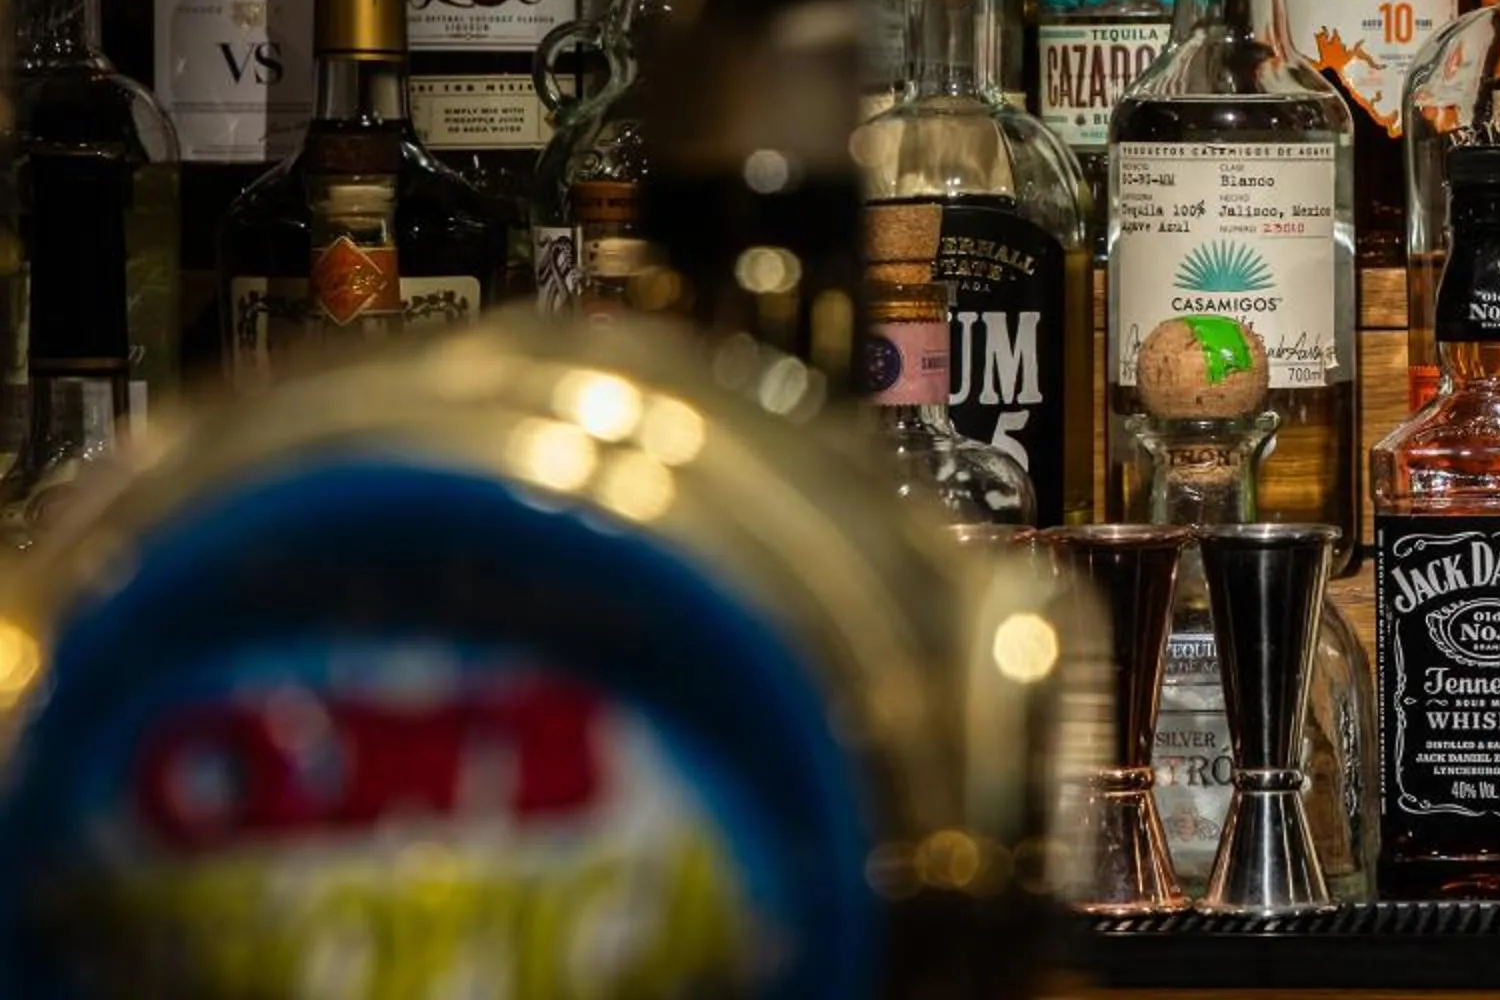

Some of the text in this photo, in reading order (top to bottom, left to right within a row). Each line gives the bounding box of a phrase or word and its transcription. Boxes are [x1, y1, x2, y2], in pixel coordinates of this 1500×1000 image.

[1378, 2, 1415, 44] 10
[1091, 29, 1158, 42] TEQUILA
[219, 42, 283, 85] VS
[1047, 45, 1163, 108] CAZADO
[1277, 146, 1292, 157] DE
[1220, 175, 1275, 188] Blanco
[1121, 199, 1207, 218] Tequila 100%
[1158, 221, 1191, 234] Azul
[940, 235, 1035, 276] ERHALL
[940, 258, 1004, 282] TATE
[1171, 297, 1278, 313] CASAMIGOS
[948, 311, 1044, 405] UM
[1391, 552, 1469, 613] JACK
[1166, 642, 1218, 658] EQUI
[1155, 732, 1216, 748] SILVER
[1425, 740, 1475, 749] DISTILLED
[1477, 741, 1485, 749] &
[1159, 746, 1234, 787] TRÓ
[1415, 753, 1446, 763] JACK
[1447, 753, 1492, 763] DANIEL
[1451, 781, 1477, 799] 40%
